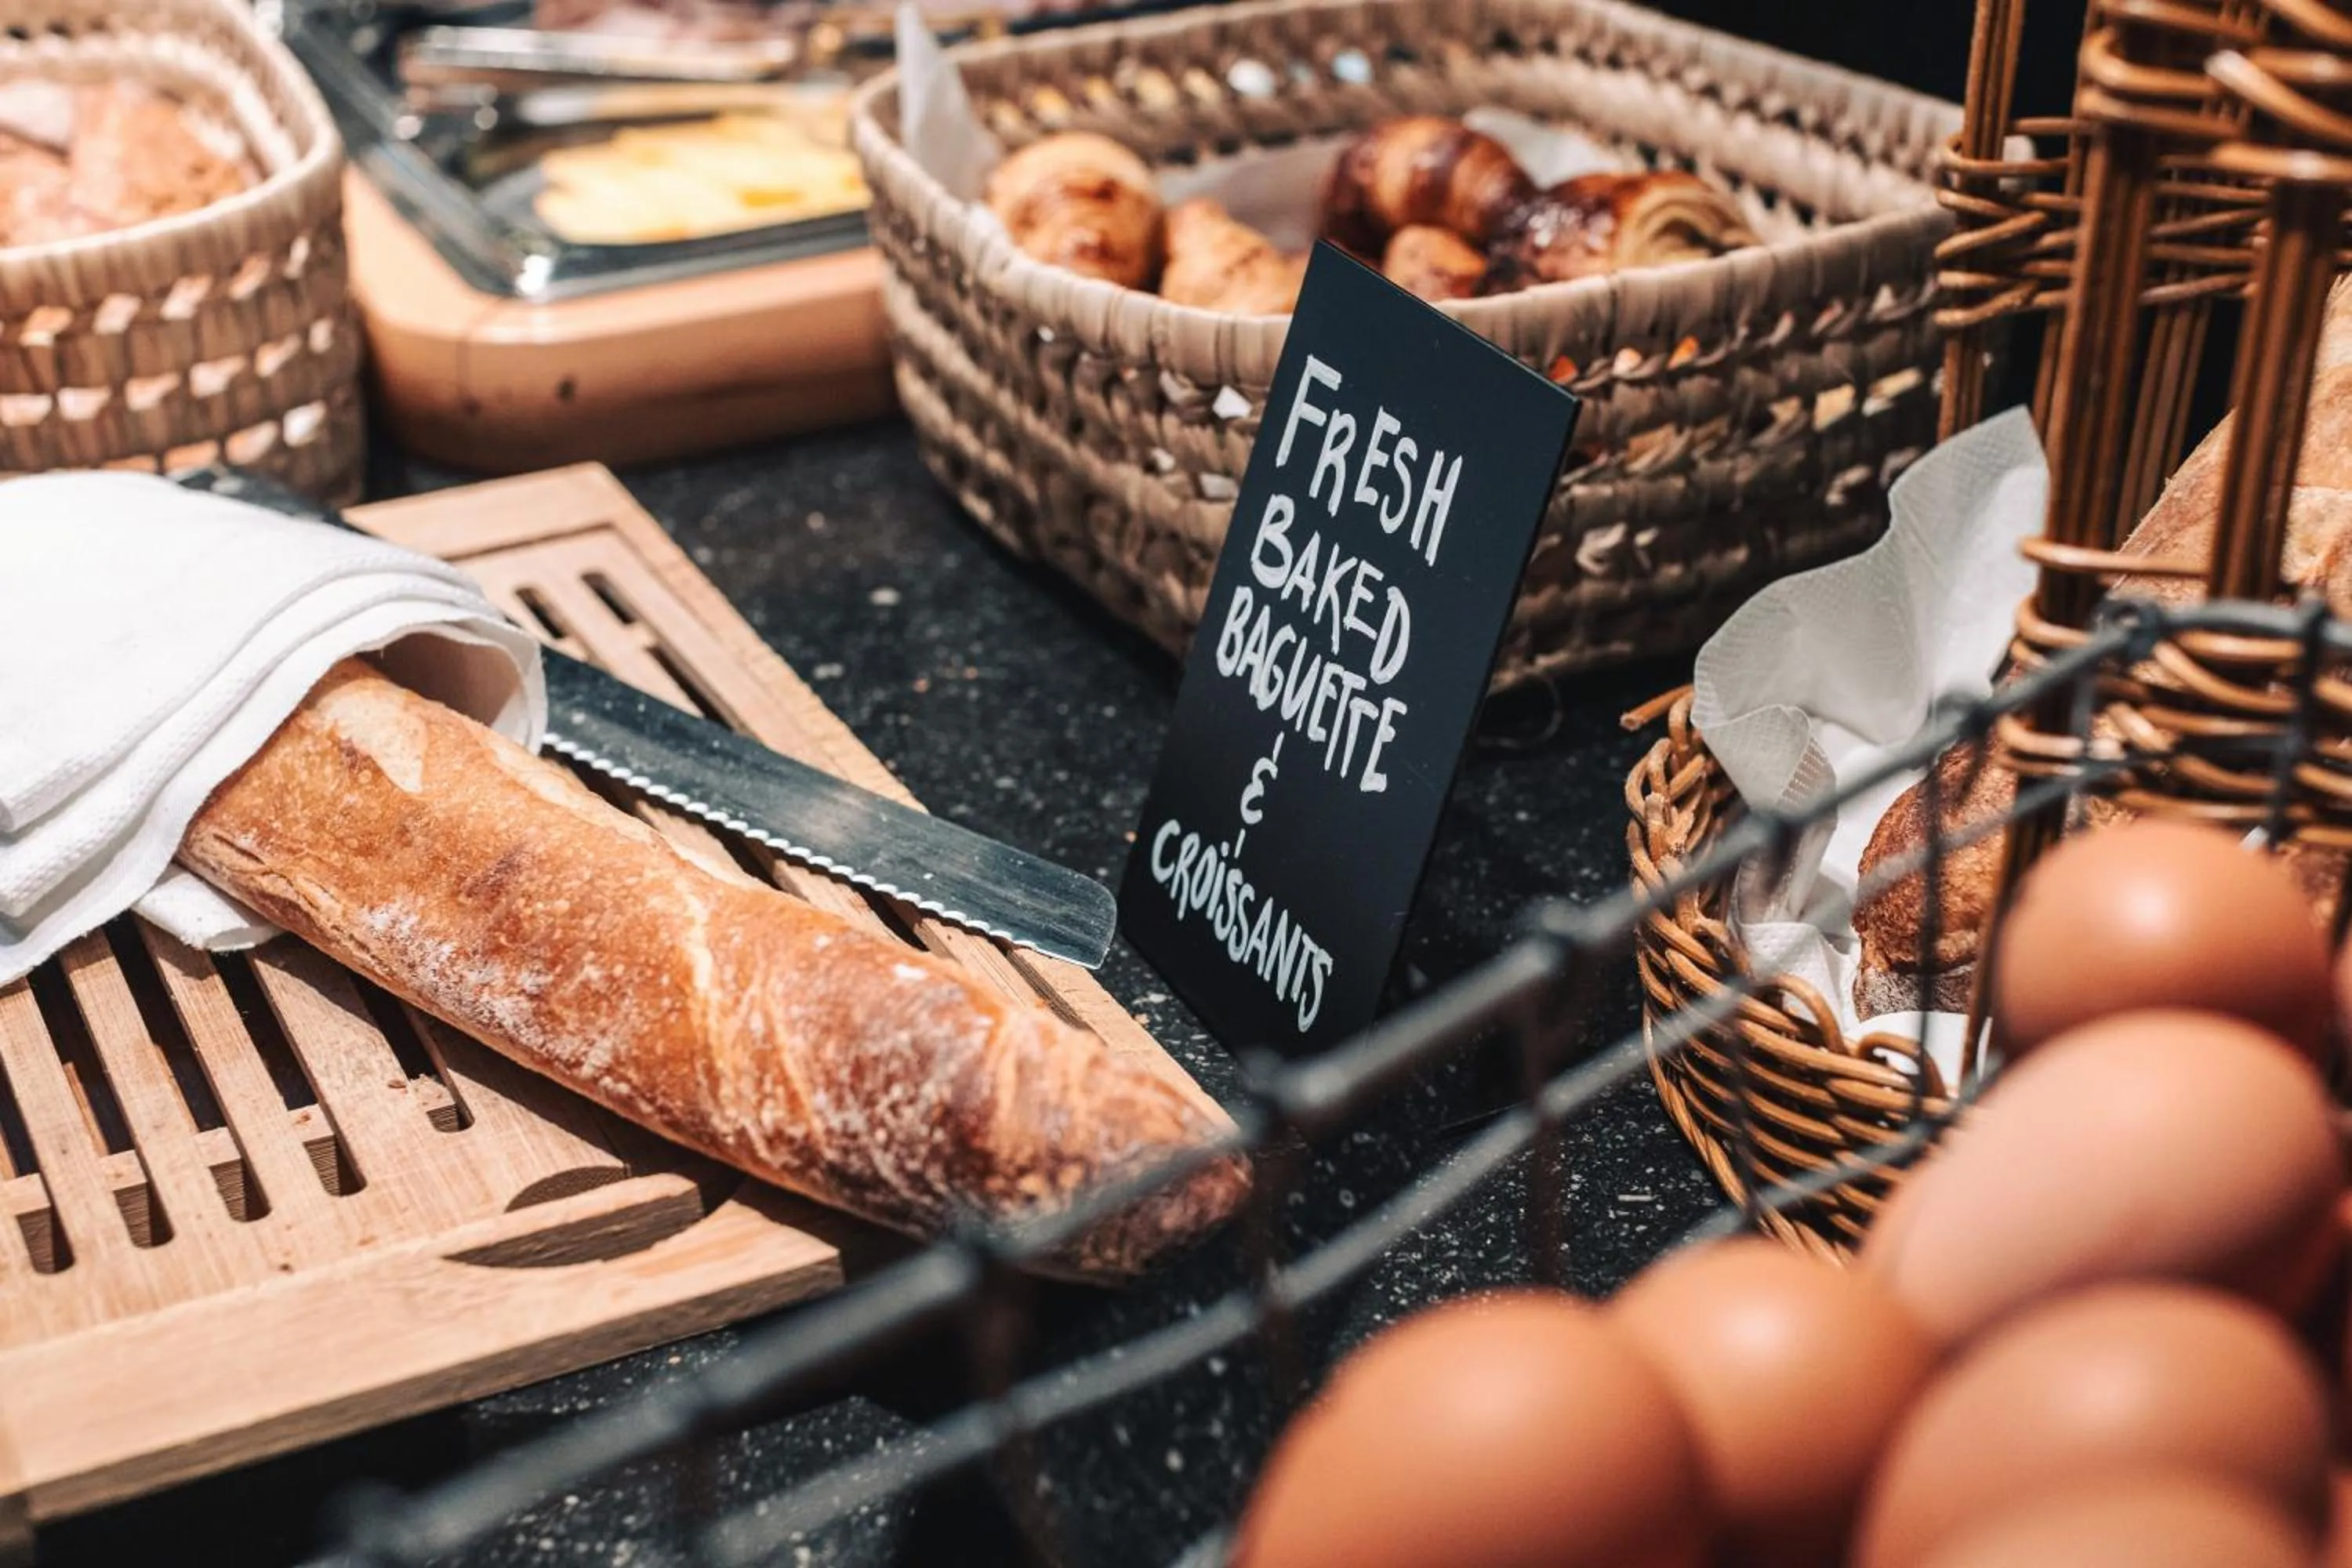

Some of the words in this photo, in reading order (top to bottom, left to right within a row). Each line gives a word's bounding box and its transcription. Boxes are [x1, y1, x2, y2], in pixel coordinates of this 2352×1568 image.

[1276, 354, 1463, 566] FRESH
[1216, 586, 1408, 793] BAGUETTE
[1250, 494, 1410, 684] BAKED
